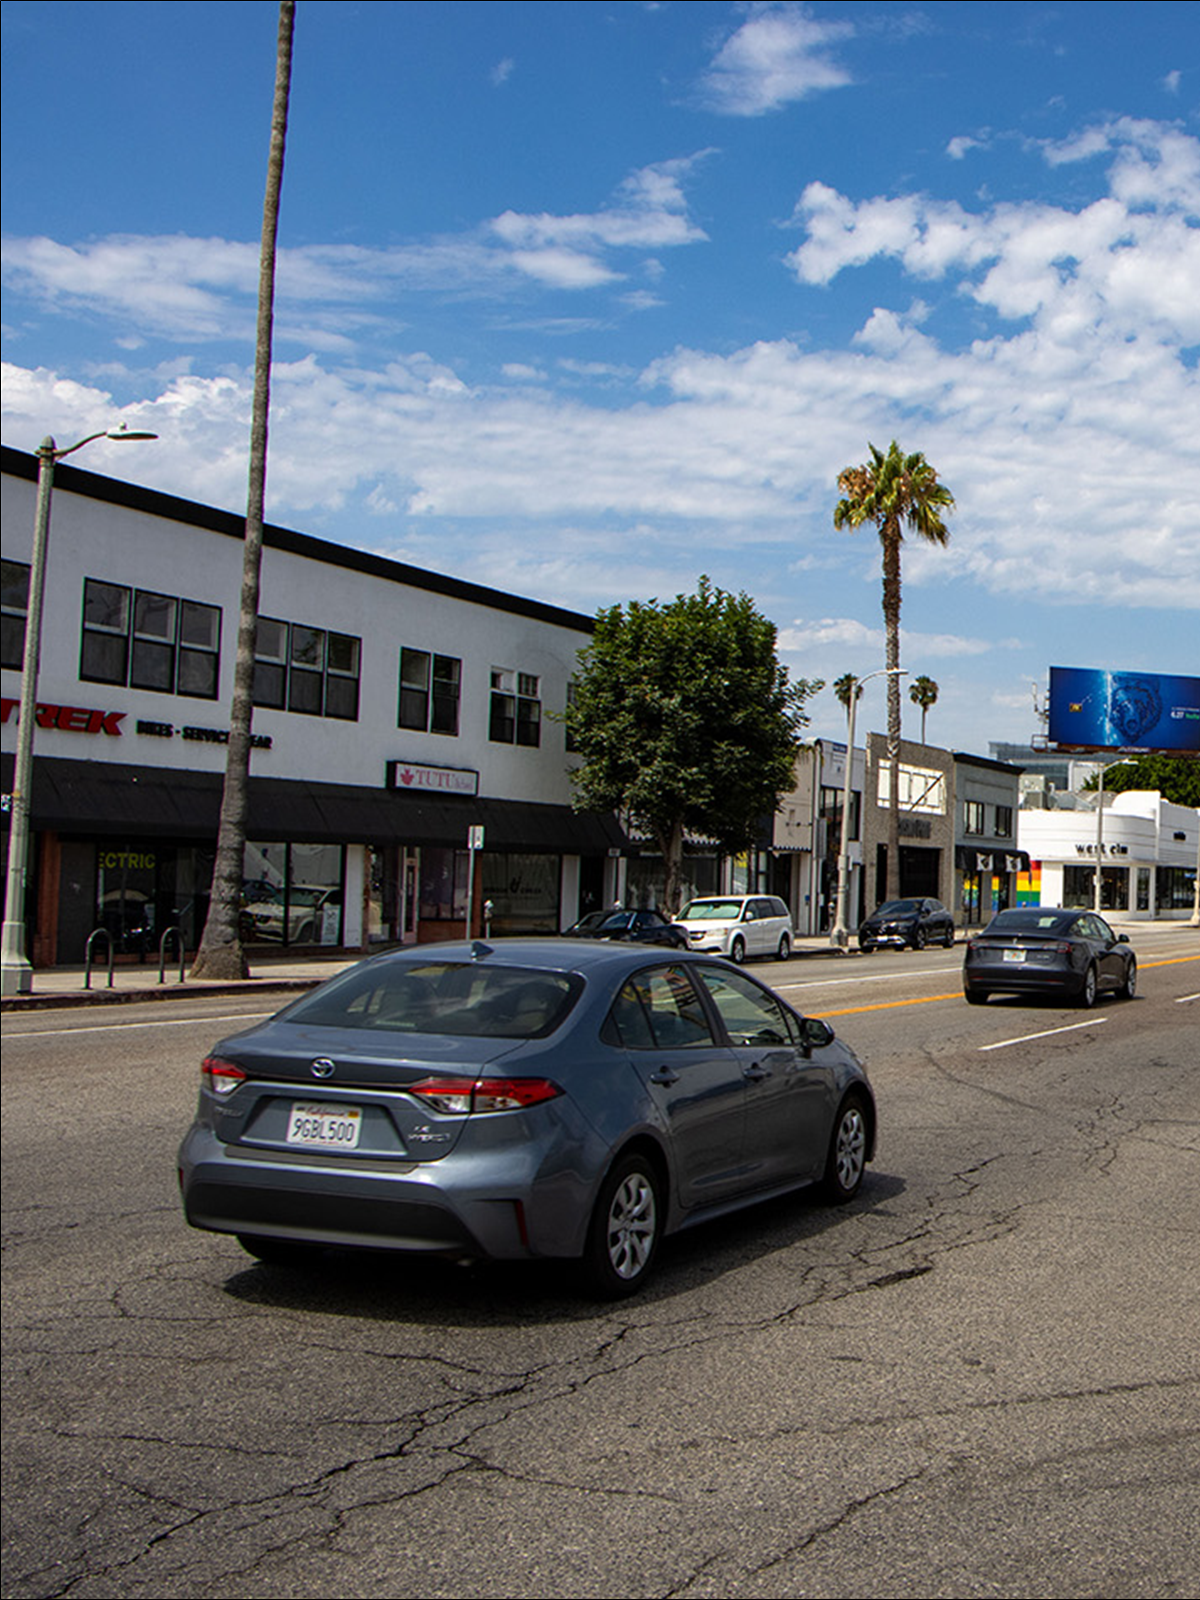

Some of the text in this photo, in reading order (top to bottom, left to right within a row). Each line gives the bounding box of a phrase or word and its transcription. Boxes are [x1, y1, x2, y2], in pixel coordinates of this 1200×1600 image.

[182, 726, 231, 745] SERVIC
[249, 734, 273, 749] EAR
[292, 1118, 356, 1142] 9GBL500
